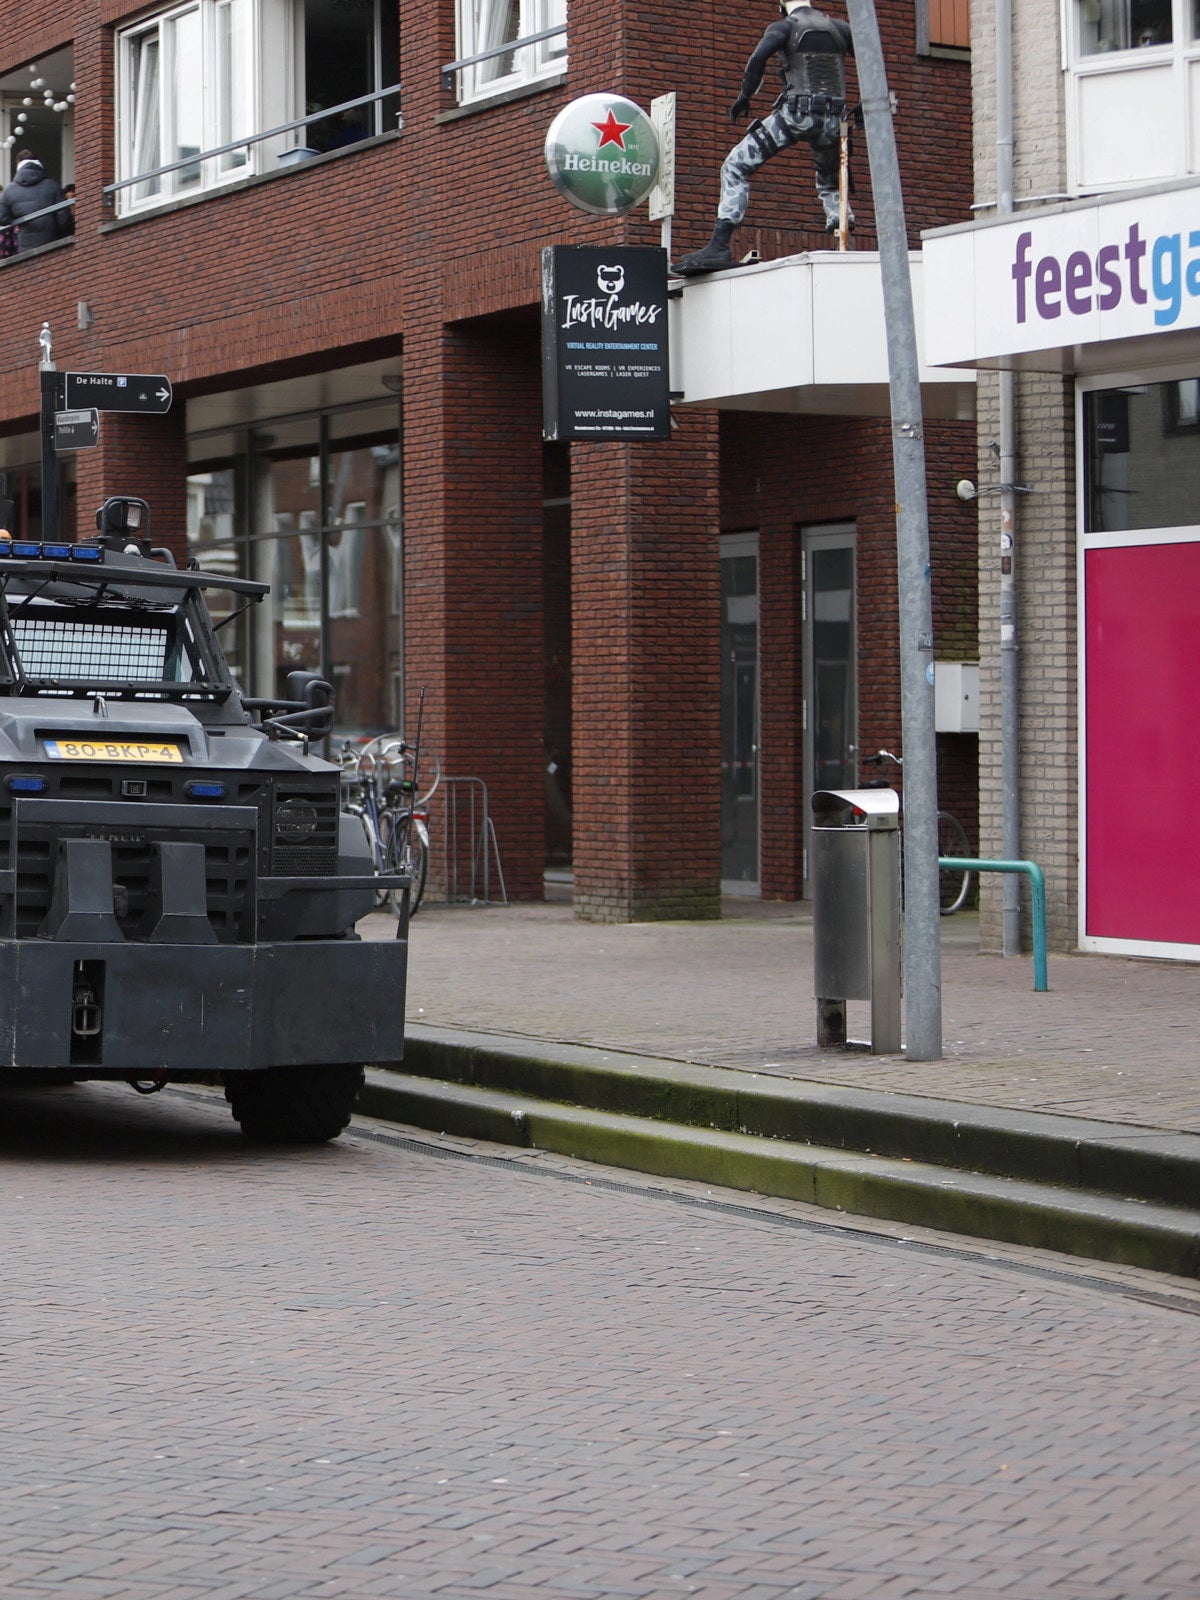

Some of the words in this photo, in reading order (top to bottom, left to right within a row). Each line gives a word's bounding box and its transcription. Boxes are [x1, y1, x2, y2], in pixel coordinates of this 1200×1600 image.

[564, 154, 651, 176] Heineken
[76, 376, 88, 385] De
[89, 376, 113, 385] Halte
[574, 408, 655, 420] www.instagames.nl
[65, 743, 174, 760] 80-BKP-4
